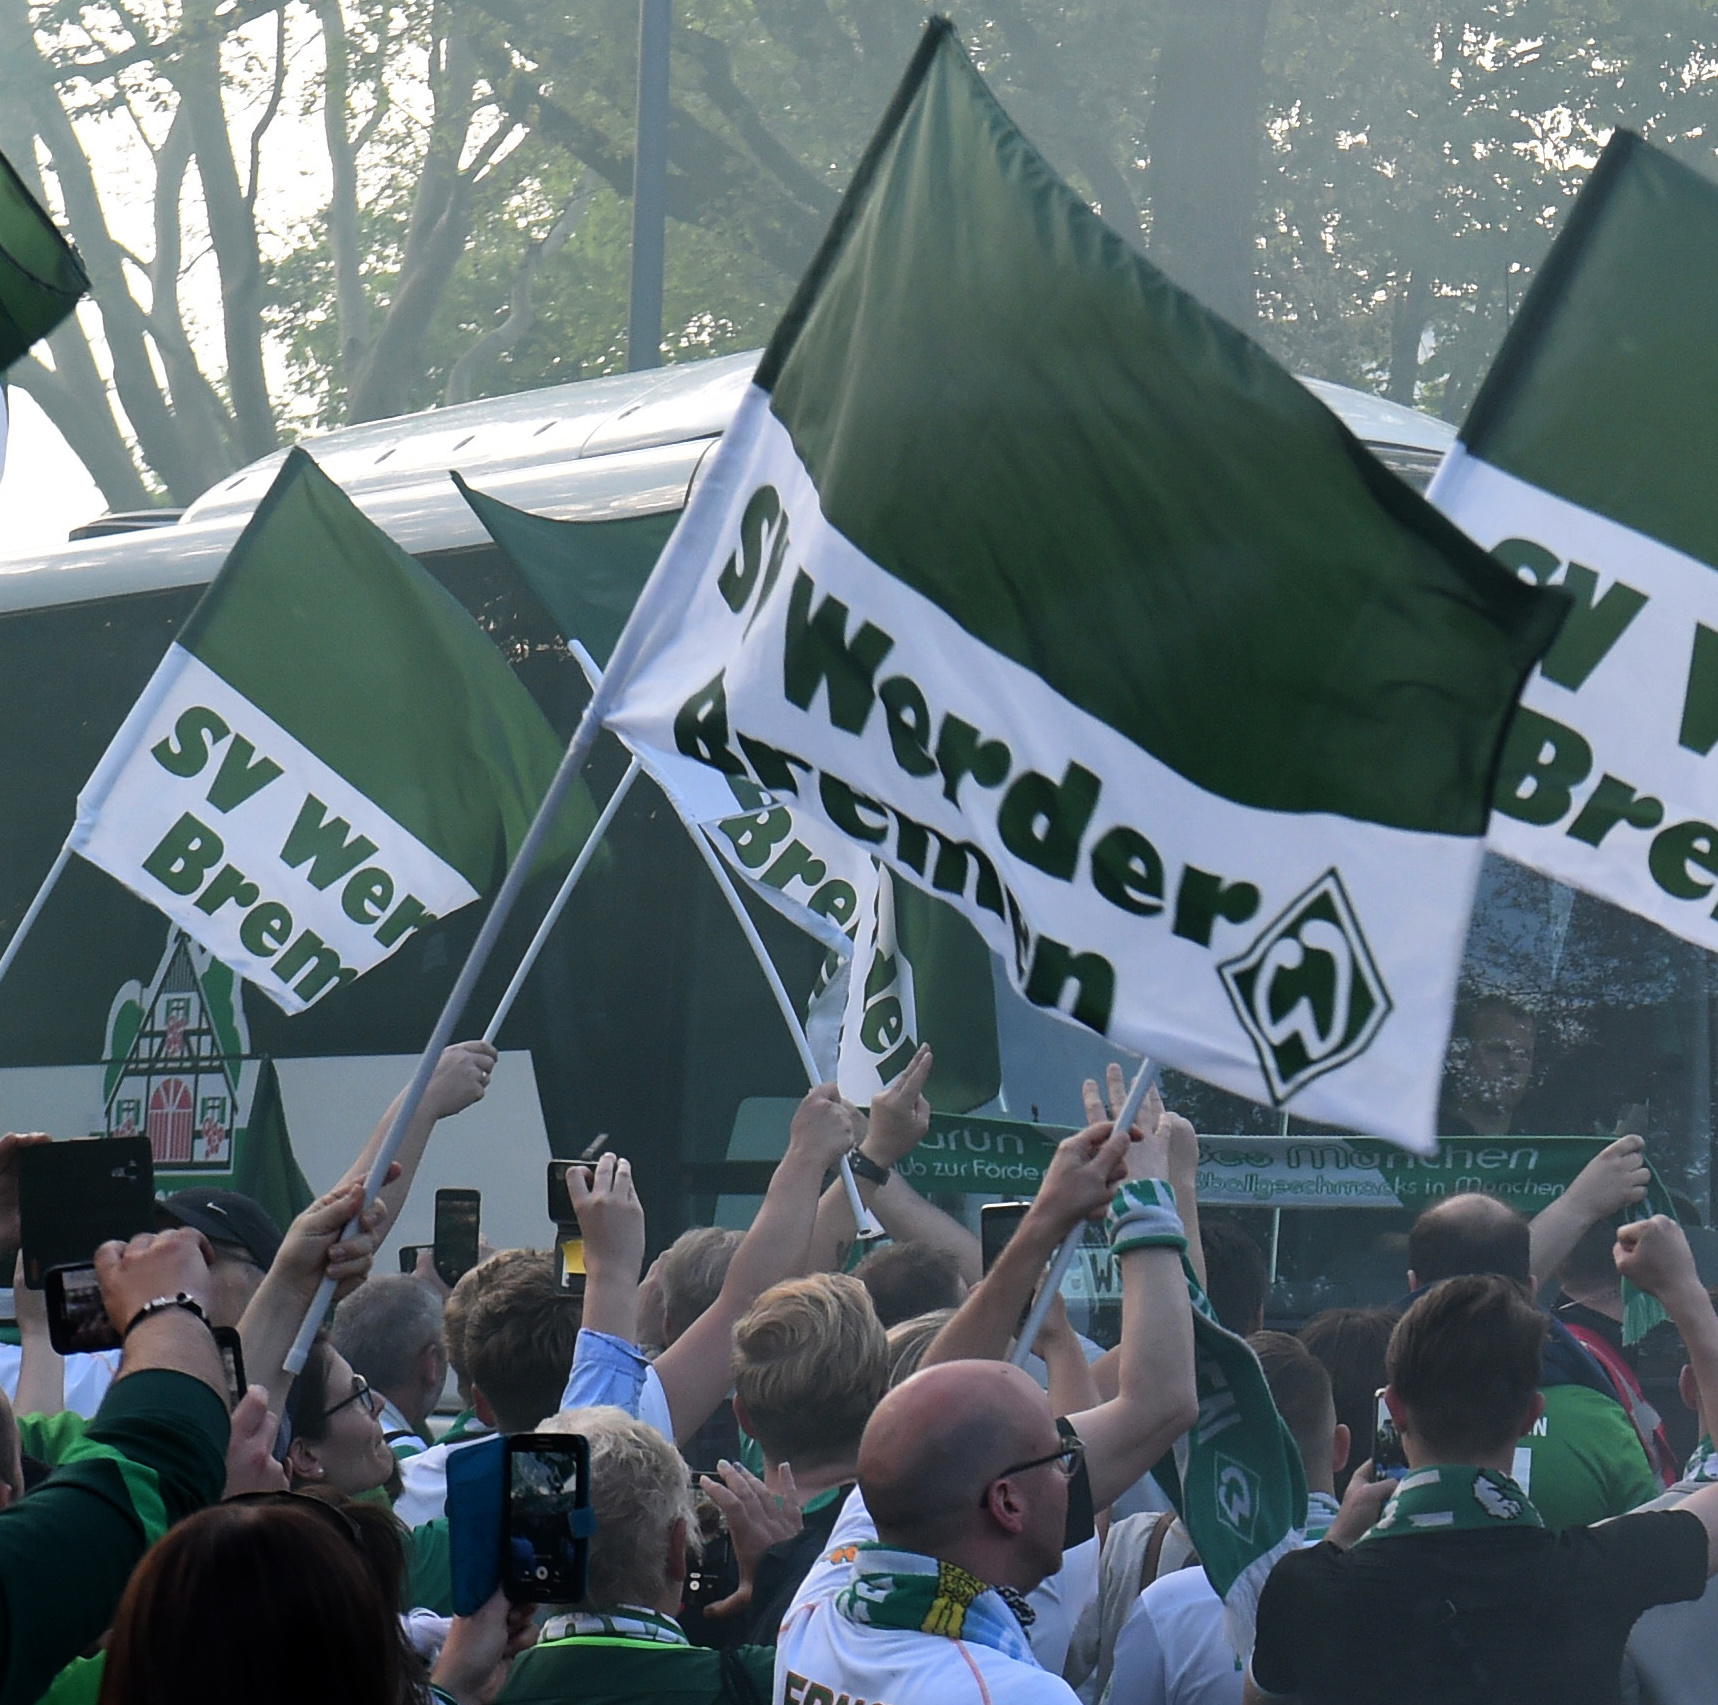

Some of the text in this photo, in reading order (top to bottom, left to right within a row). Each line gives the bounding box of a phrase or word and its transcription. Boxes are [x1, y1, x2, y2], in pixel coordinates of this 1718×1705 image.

[717, 484, 1261, 949] S Werder
[141, 810, 361, 1004] Brem
[150, 705, 439, 948] SV Wer
[932, 1161, 968, 1177] zur
[1424, 1177, 1446, 1196] in
